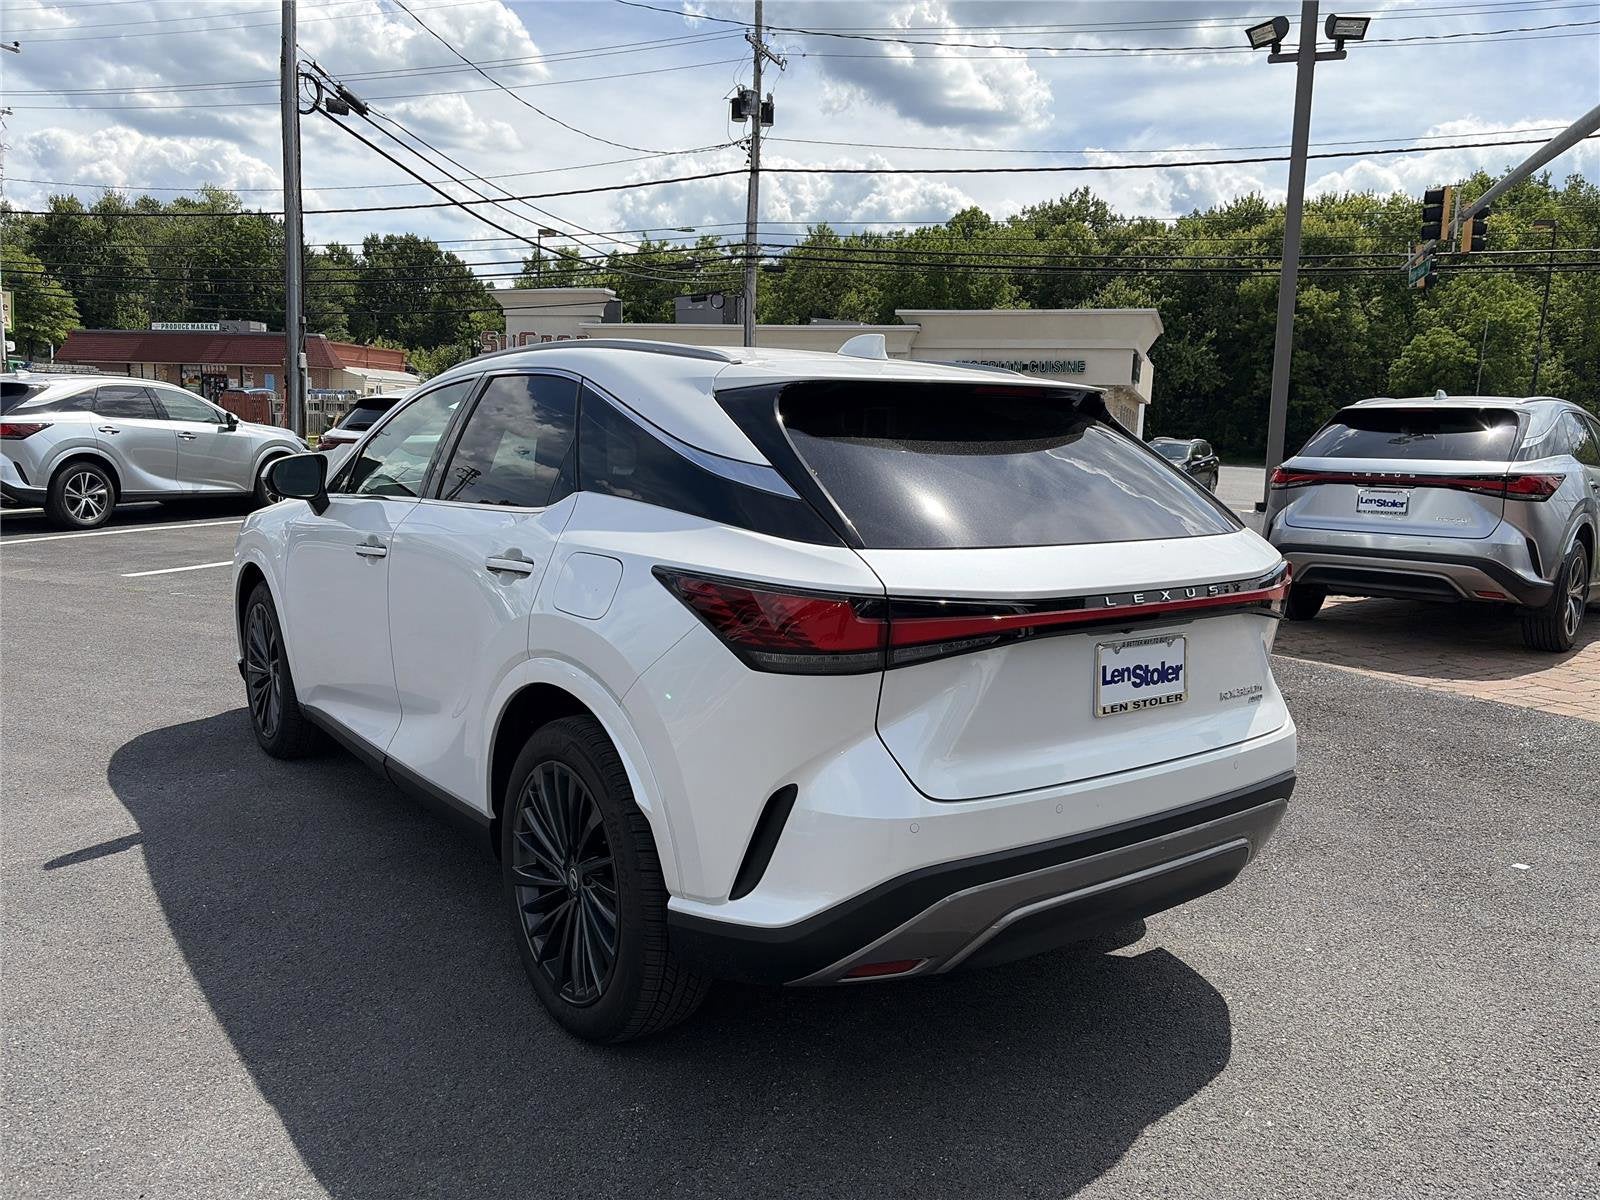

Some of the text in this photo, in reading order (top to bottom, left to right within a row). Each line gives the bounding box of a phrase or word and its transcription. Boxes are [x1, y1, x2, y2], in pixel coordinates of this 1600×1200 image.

[1028, 360, 1086, 373] CUISINE
[1105, 585, 1219, 606] LEXUS
[1102, 693, 1183, 715] LEN STOLER
